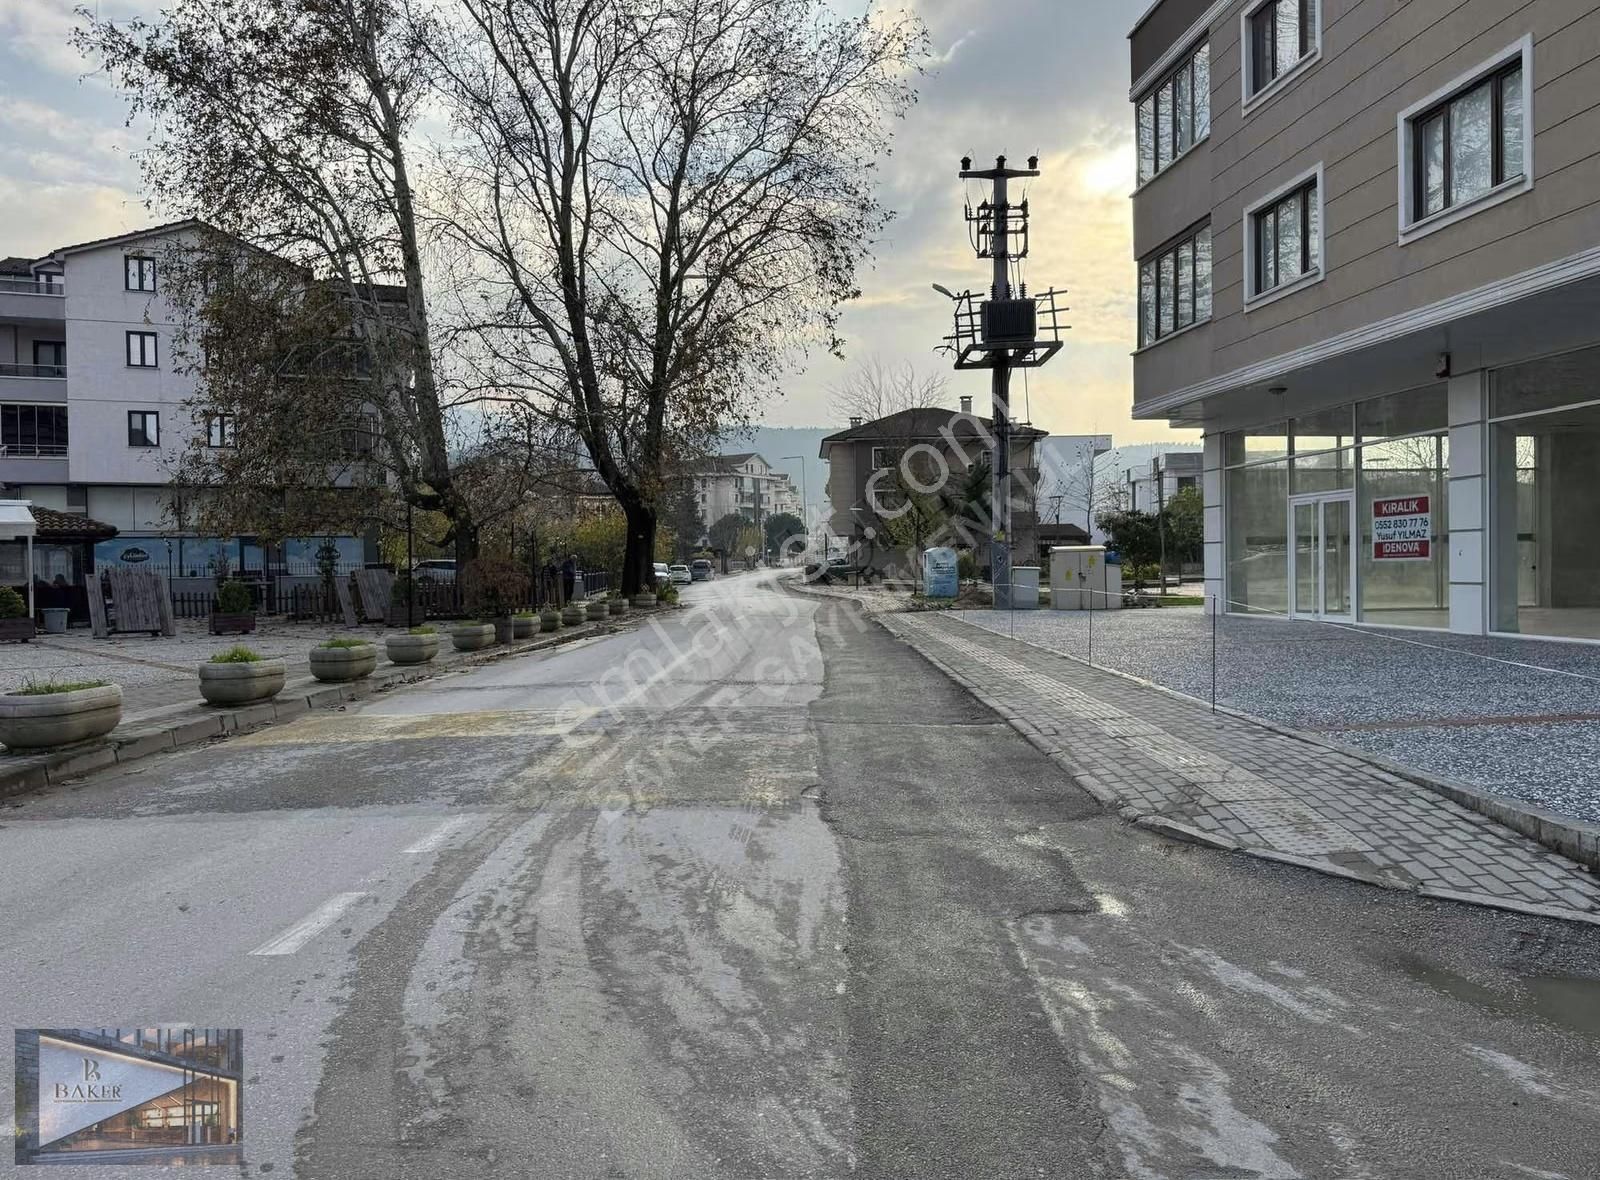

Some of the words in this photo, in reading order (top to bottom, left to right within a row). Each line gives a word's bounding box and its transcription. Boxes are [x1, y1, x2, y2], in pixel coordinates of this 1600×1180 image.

[1375, 520, 1392, 529] 0552
[1393, 519, 1408, 529] 830
[1409, 518, 1418, 528] 77
[1419, 517, 1429, 528] 76
[1376, 531, 1396, 541] Yusuf
[1397, 529, 1426, 539] YILMAZ
